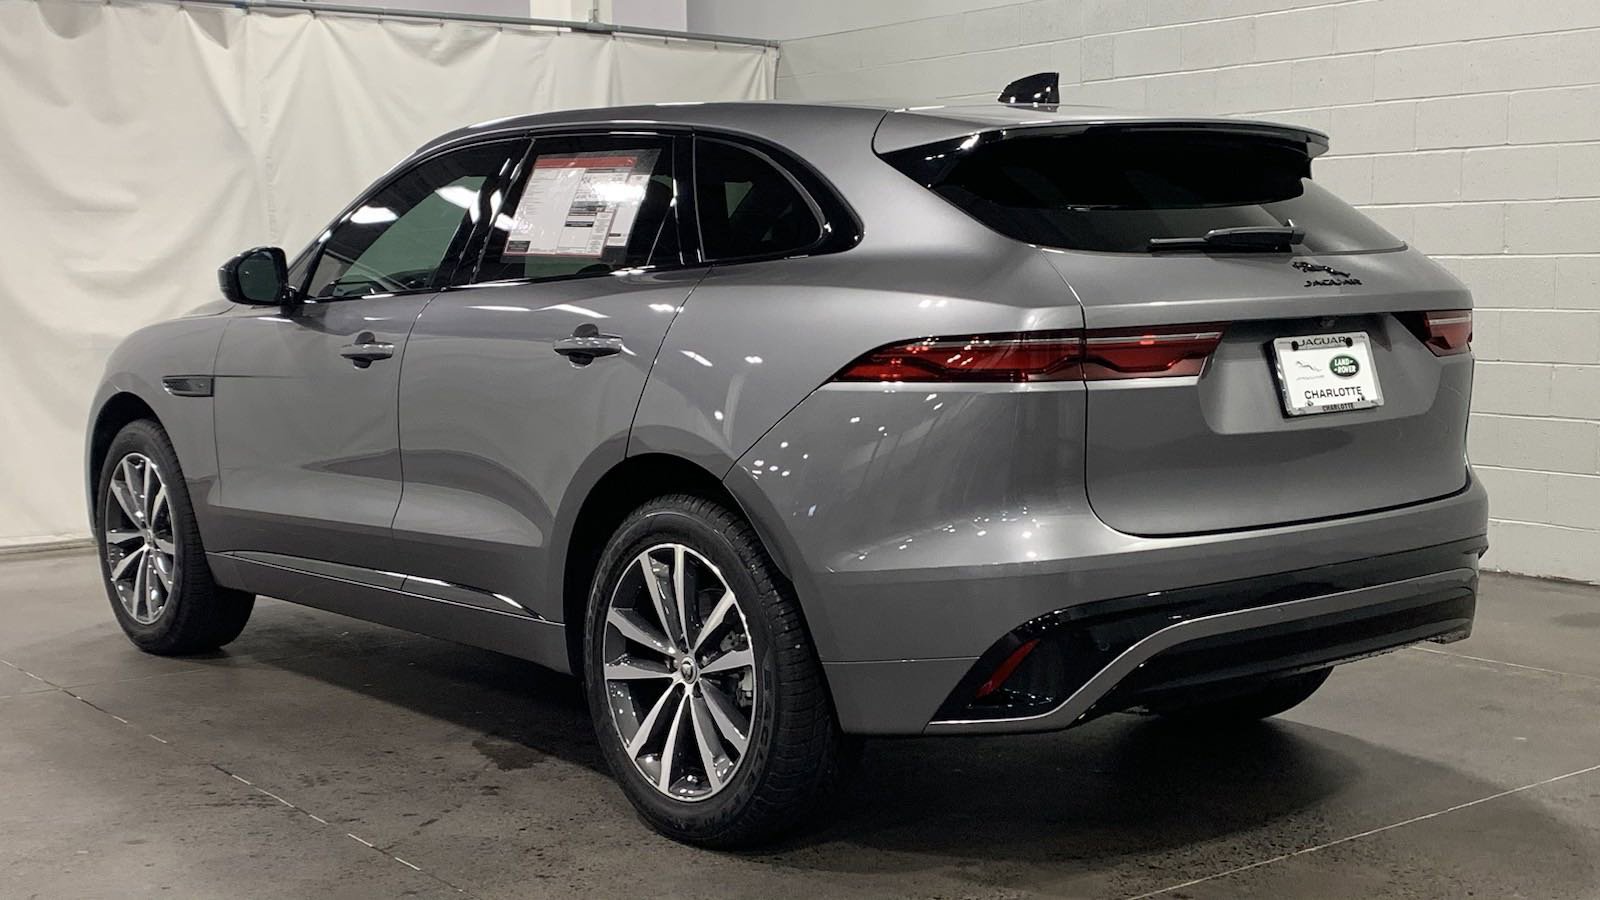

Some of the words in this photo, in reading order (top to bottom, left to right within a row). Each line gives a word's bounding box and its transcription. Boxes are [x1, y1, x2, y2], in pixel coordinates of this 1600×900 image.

[1298, 336, 1347, 347] JAGUAR
[1304, 386, 1362, 400] CHARLOTTE
[1322, 402, 1354, 412] CHARLOTTE
